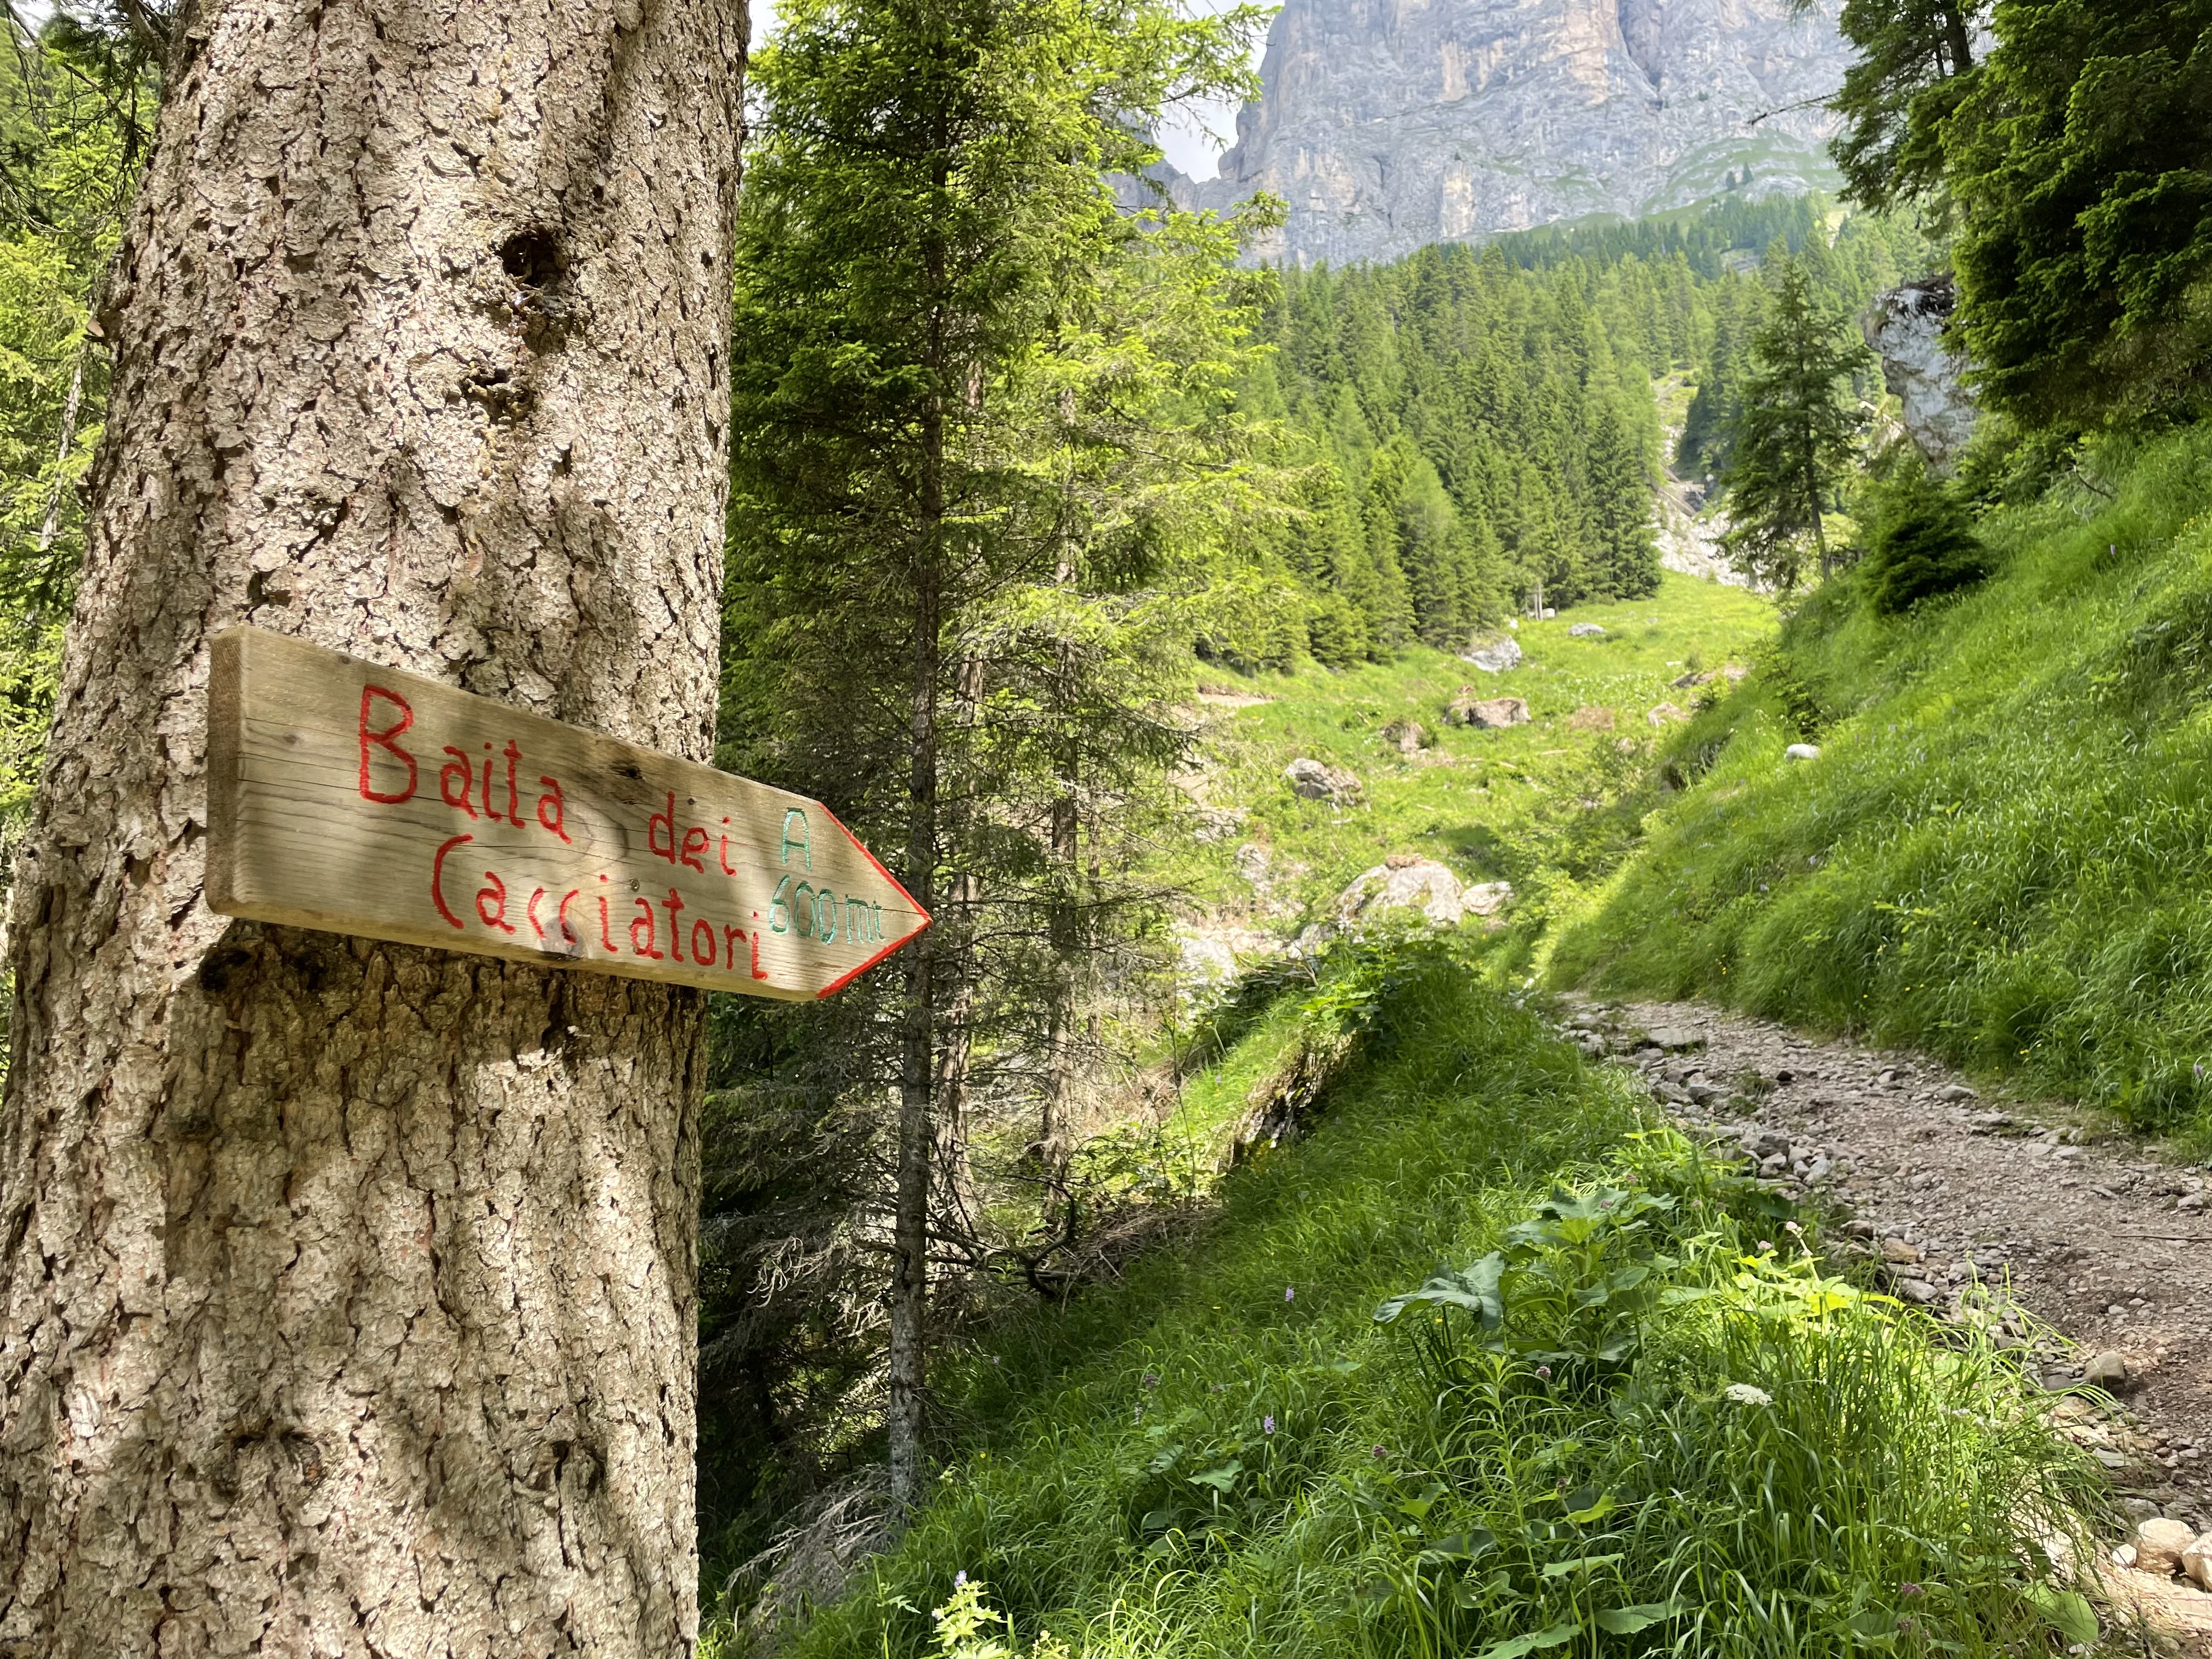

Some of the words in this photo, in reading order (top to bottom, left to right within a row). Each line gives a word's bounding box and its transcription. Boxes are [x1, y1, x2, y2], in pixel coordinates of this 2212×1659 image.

[359, 685, 572, 845] Baita
[648, 791, 738, 877] dei
[782, 807, 812, 871] A
[432, 833, 769, 980] Cacciatori
